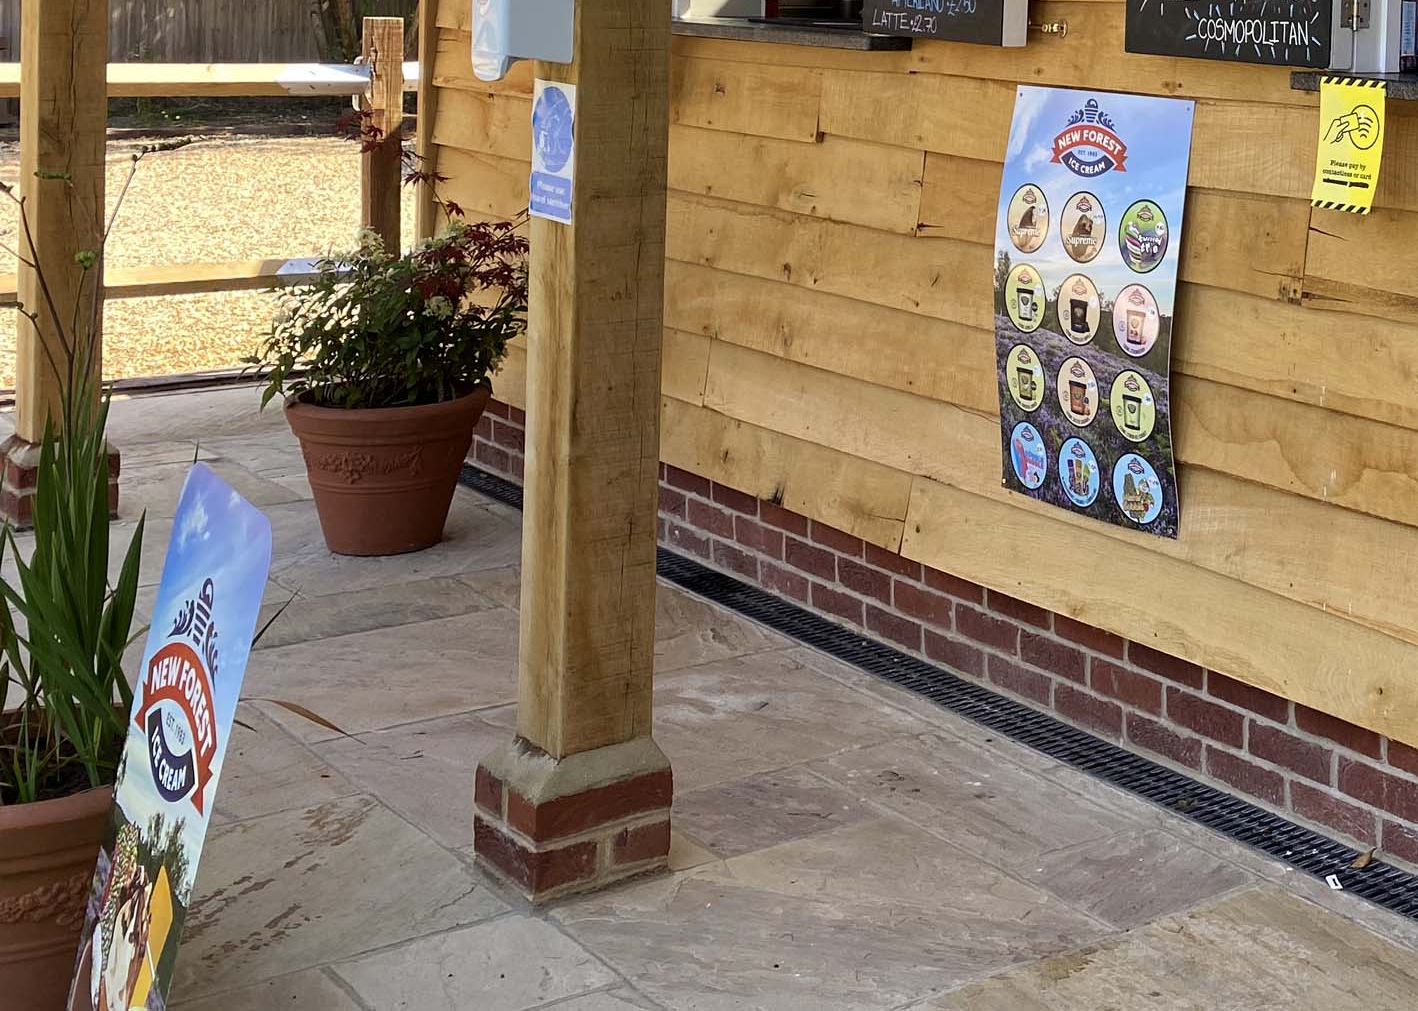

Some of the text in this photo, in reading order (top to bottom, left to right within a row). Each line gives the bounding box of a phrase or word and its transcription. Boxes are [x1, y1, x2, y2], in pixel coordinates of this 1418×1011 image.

[872, 8, 910, 30] LATTE
[1198, 18, 1309, 46] COSMOPOLITAN
[1058, 130, 1122, 155] NEW FOREST
[1068, 157, 1106, 174] ICE CREAM
[1330, 159, 1348, 167] Please
[1066, 235, 1097, 247] Supreme
[150, 656, 212, 757] NEW FOREST
[151, 726, 187, 791] ICE CREAM
